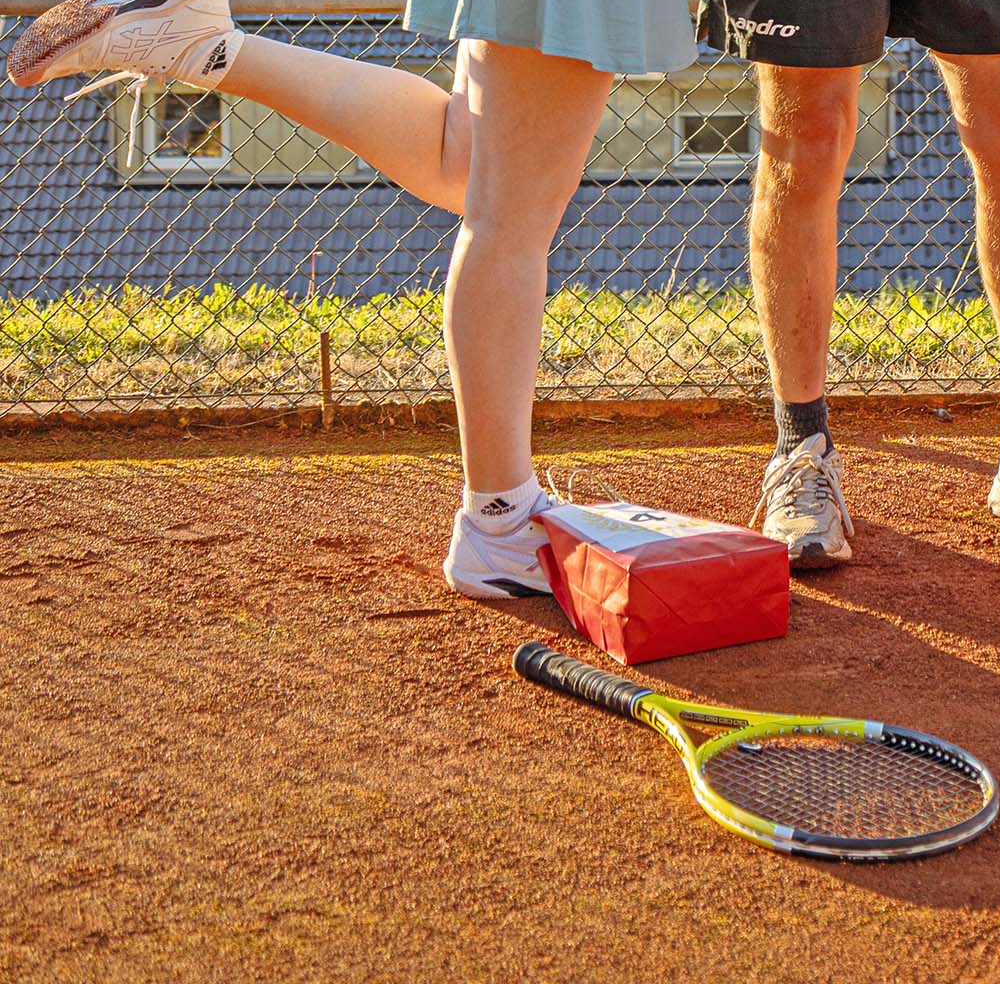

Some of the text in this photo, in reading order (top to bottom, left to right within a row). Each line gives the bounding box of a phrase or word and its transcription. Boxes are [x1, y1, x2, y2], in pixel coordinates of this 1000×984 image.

[735, 17, 800, 38] andro
[201, 39, 226, 76] adidas
[480, 505, 516, 516] adidas
